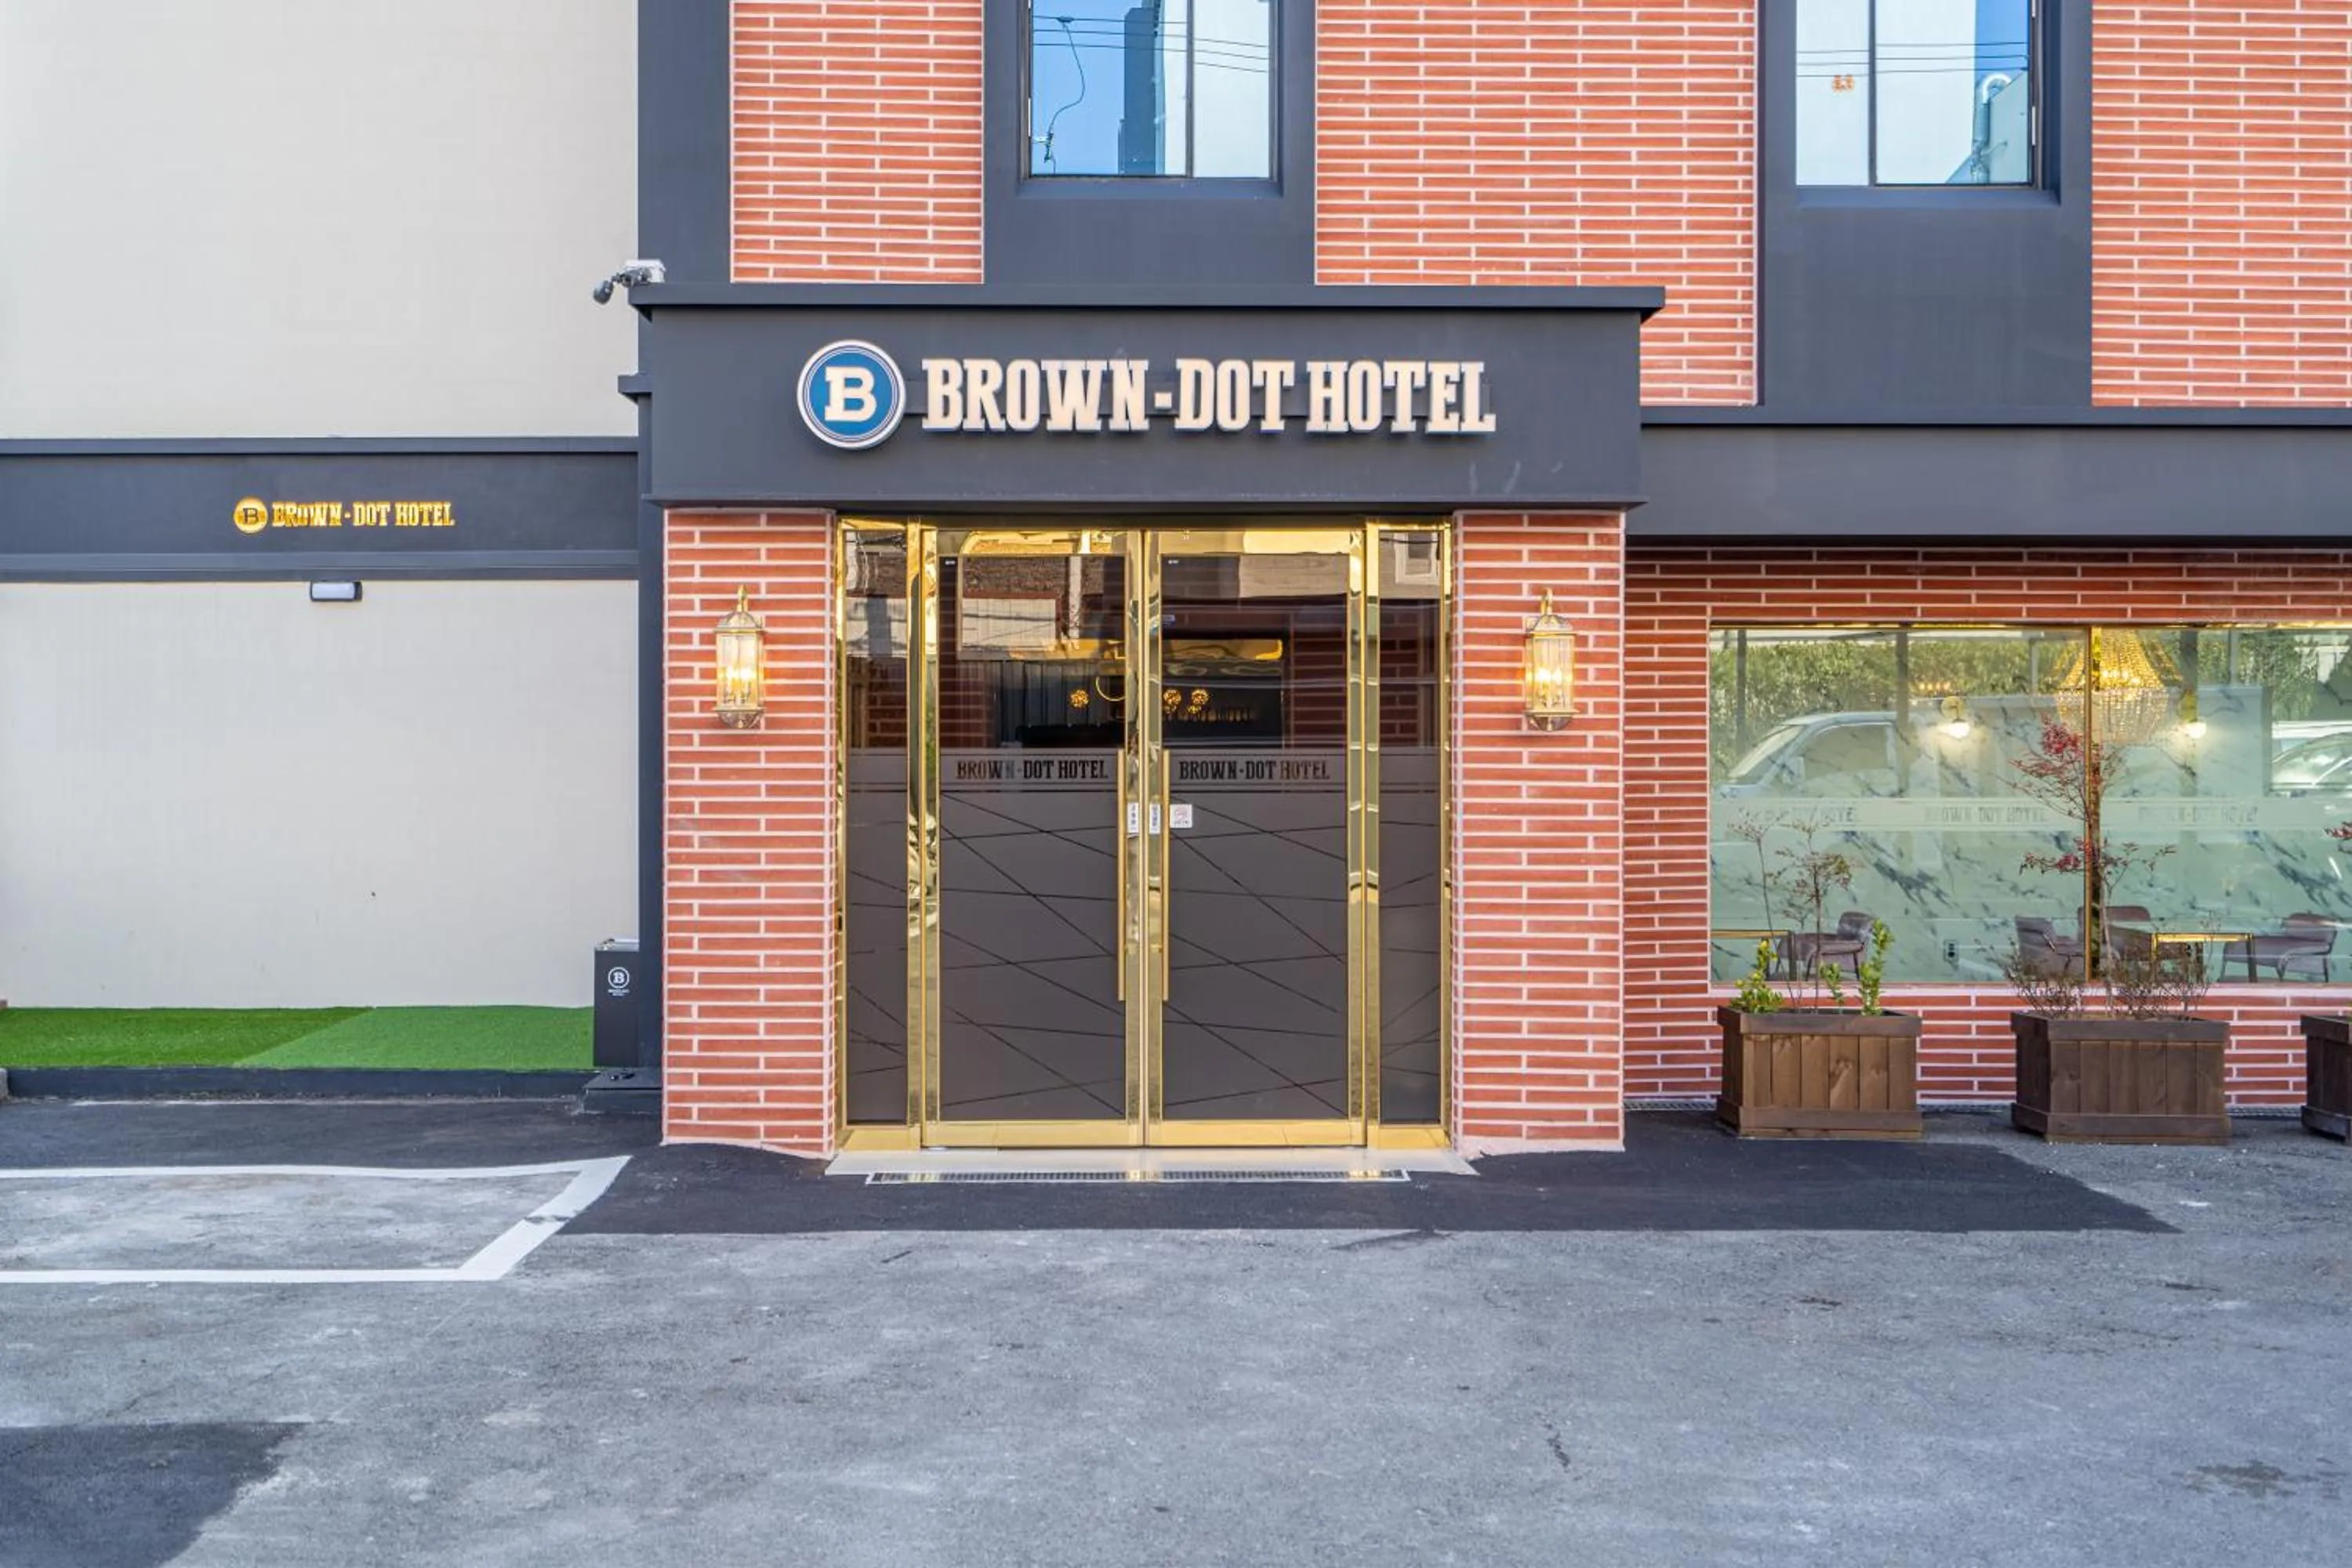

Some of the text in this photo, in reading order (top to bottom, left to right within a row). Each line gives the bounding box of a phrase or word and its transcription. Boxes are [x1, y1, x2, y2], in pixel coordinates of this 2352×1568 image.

[824, 365, 877, 423] B
[1305, 361, 1497, 434] HOTEL
[394, 502, 456, 527] HOTEL
[1058, 760, 1109, 779] HOTEL
[1280, 760, 1330, 780] HOTEL
